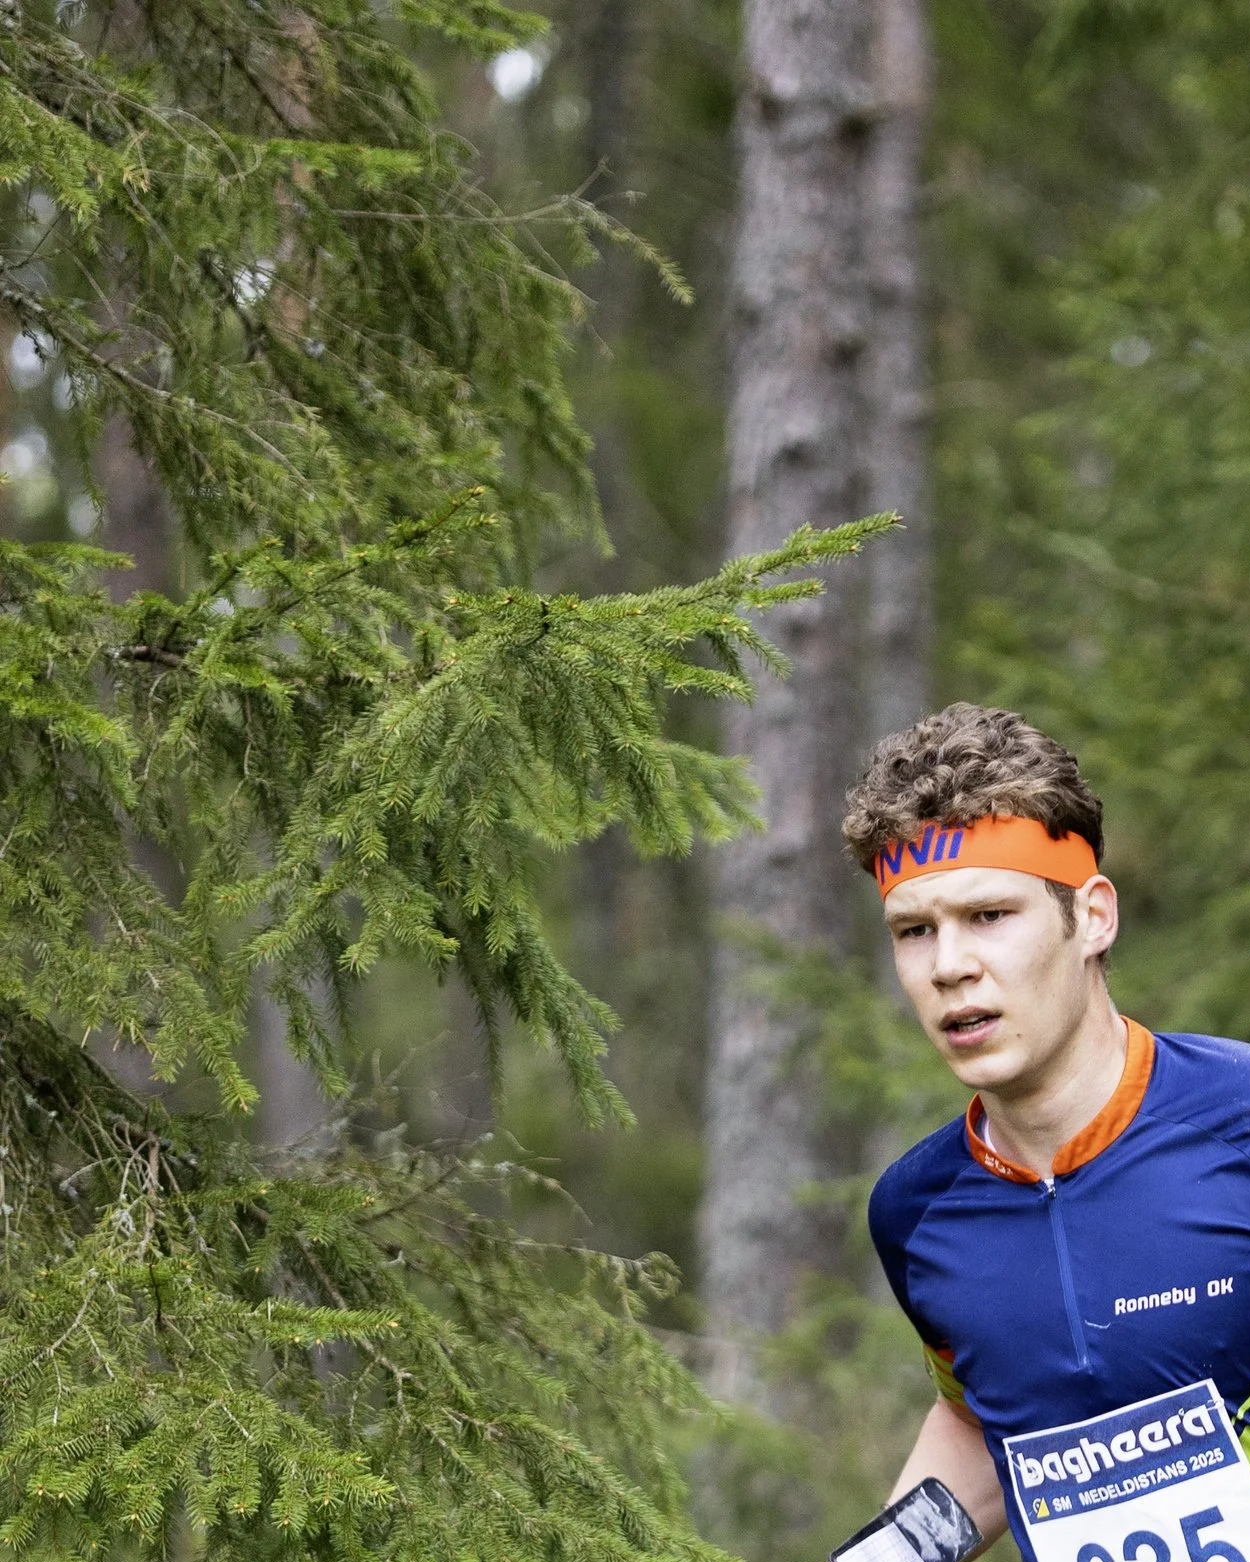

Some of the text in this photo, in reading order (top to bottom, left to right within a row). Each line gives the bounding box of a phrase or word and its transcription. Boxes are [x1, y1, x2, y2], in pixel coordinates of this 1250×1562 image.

[1114, 1277, 1234, 1316] Ronneby OK
[1017, 1404, 1215, 1489] bagheera
[1052, 1448, 1225, 1512] SM MEDELDISTANS 2025
